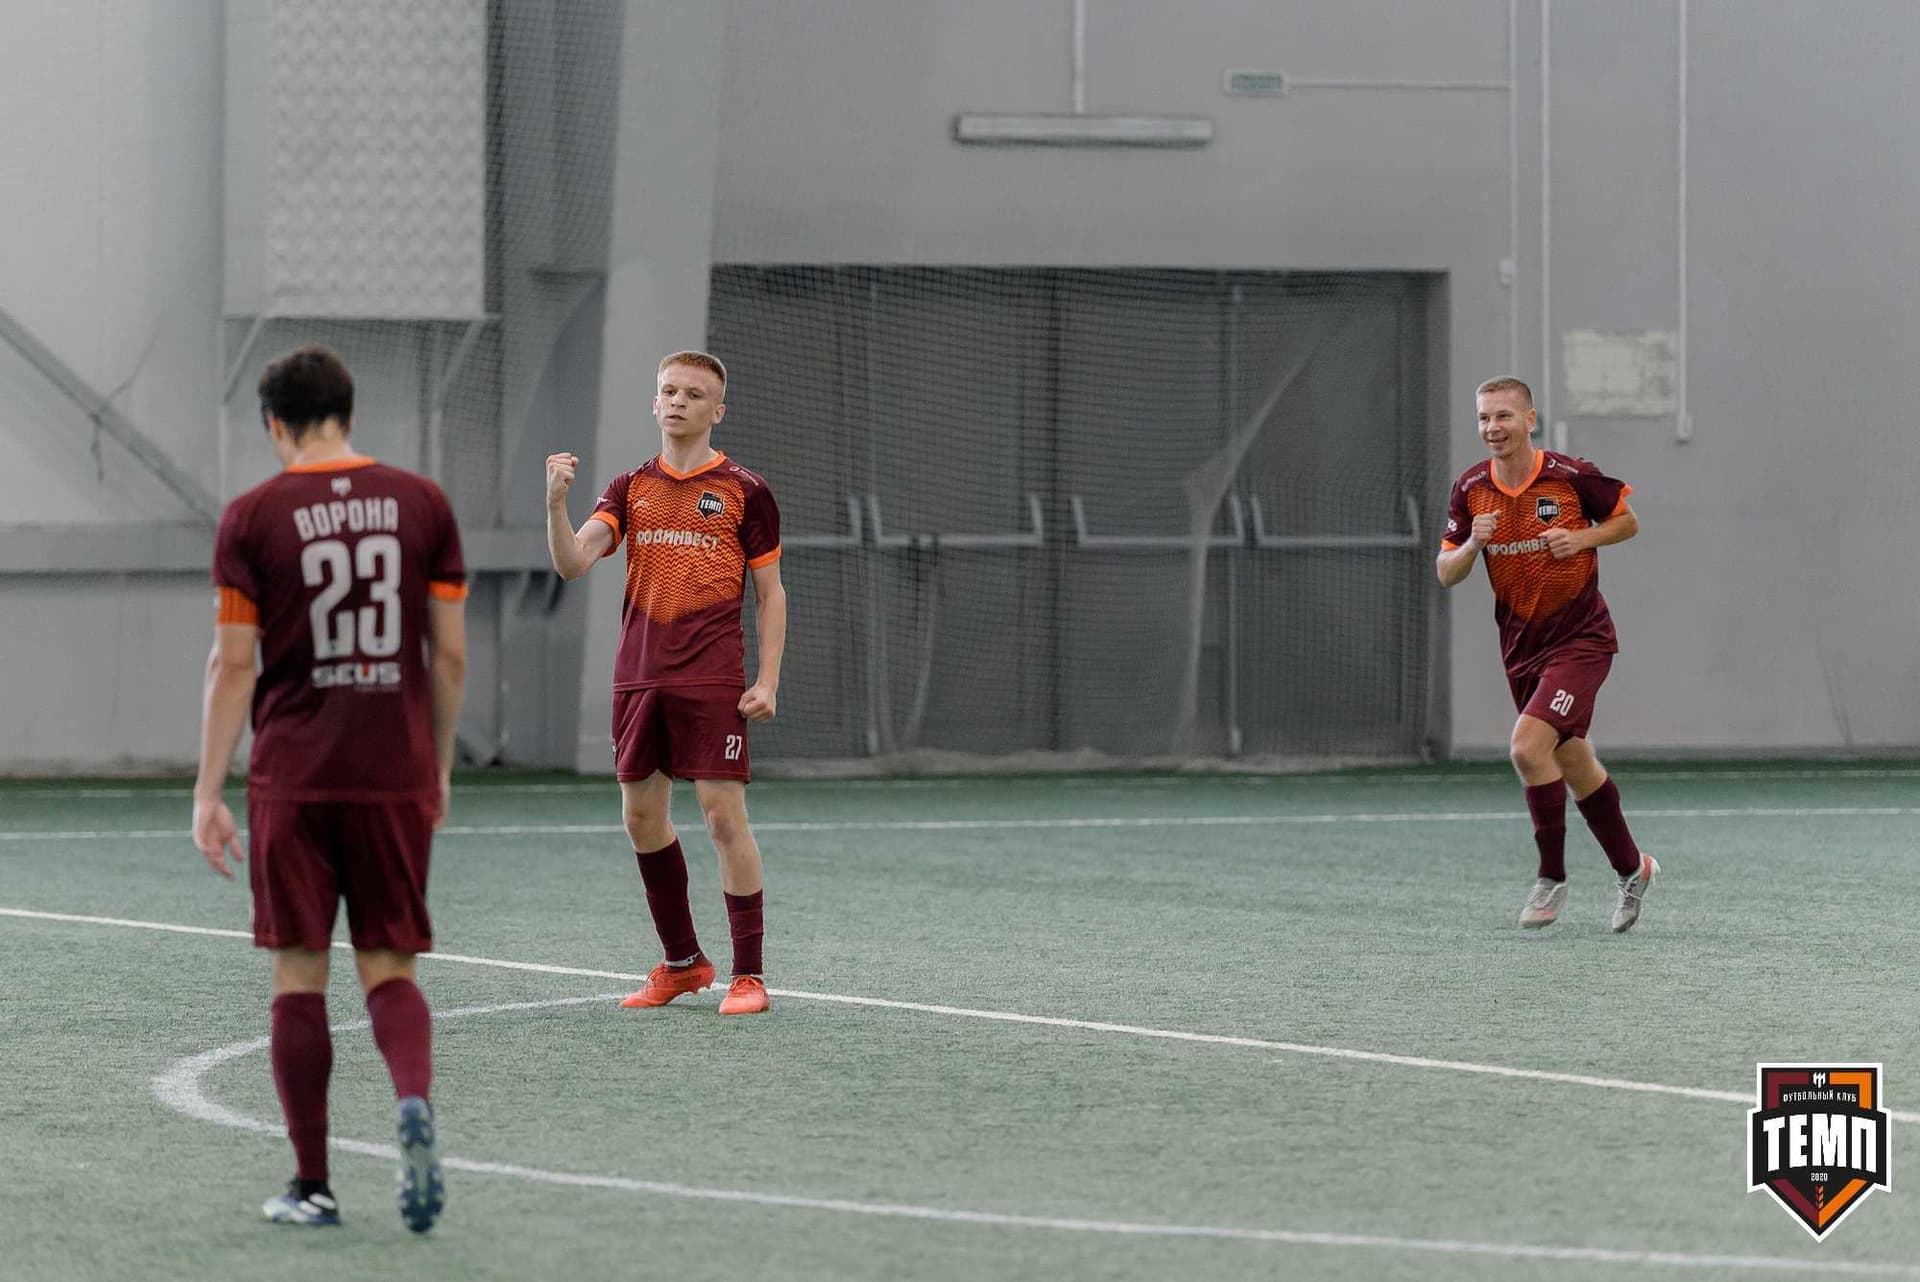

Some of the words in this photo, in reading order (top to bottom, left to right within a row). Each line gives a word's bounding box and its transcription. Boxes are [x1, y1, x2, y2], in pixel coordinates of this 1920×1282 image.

[293, 497, 399, 541] ВОРОНА
[699, 499, 723, 513] ТЕМП
[301, 534, 401, 660] 23
[1549, 689, 1575, 717] 20
[725, 735, 742, 760] 27
